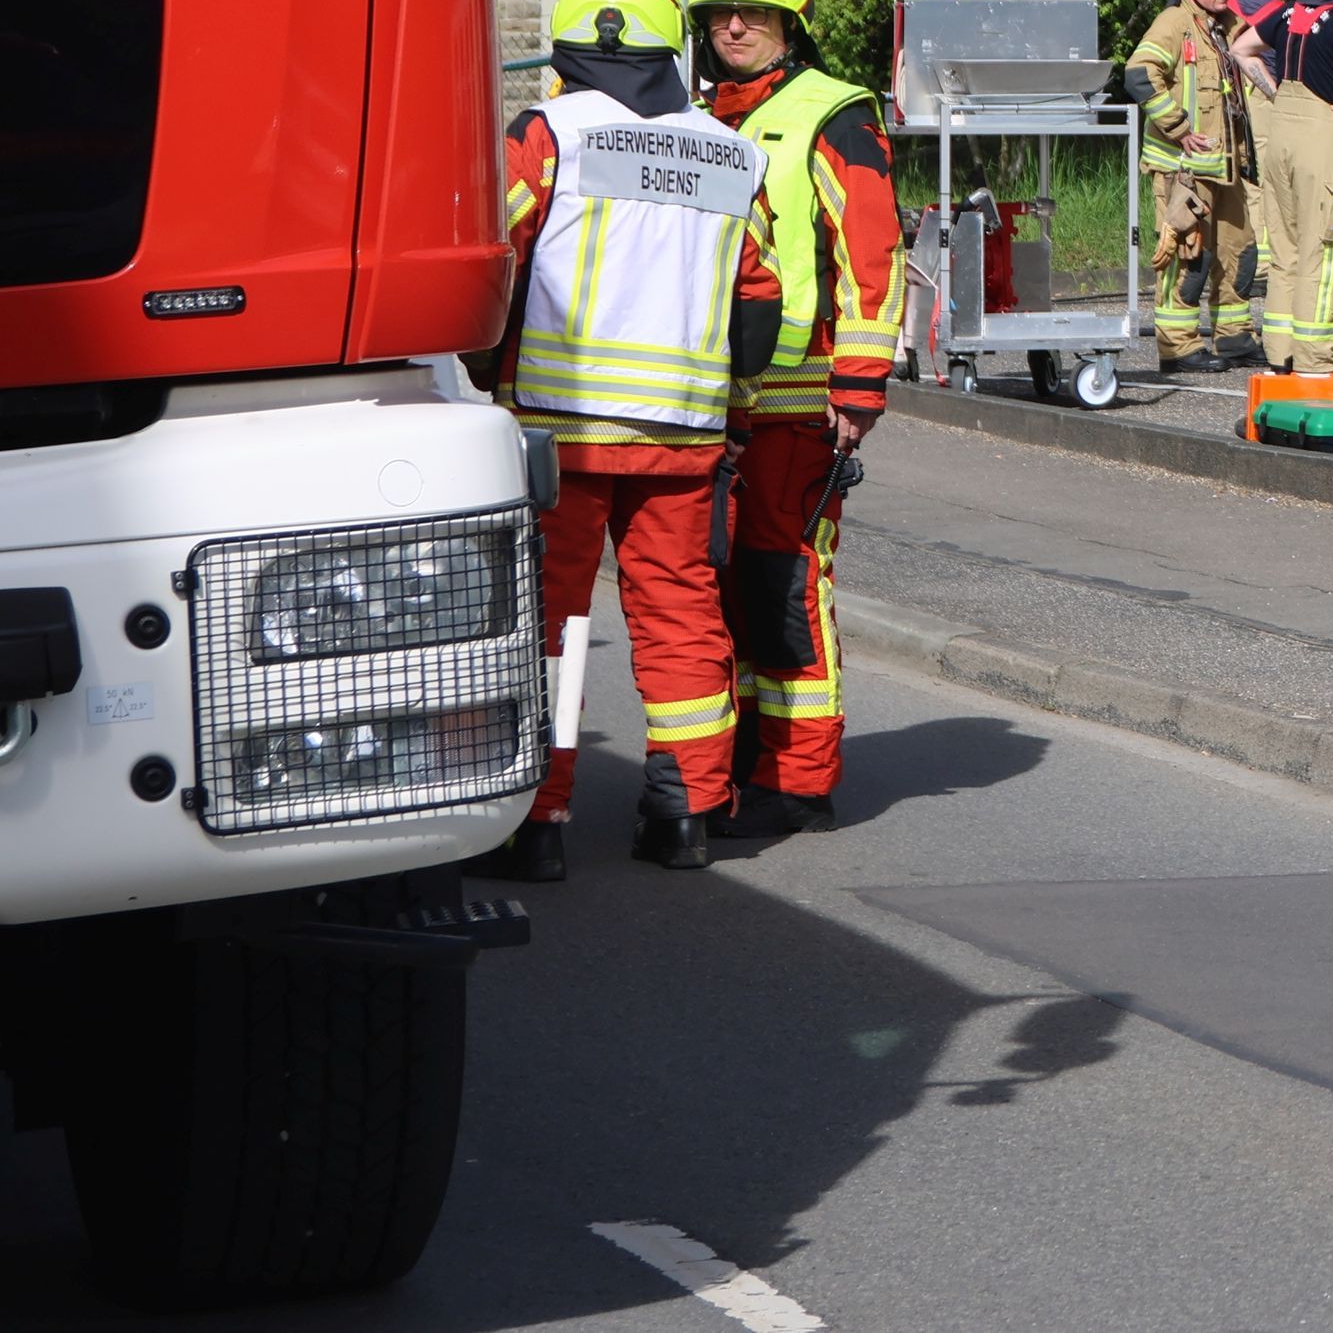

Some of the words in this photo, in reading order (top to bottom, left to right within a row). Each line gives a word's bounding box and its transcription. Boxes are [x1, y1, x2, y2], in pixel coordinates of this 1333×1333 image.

[587, 130, 674, 159] FEUERWEHR
[678, 135, 748, 171] WALDBRÖL
[641, 166, 701, 197] B-DIENST
